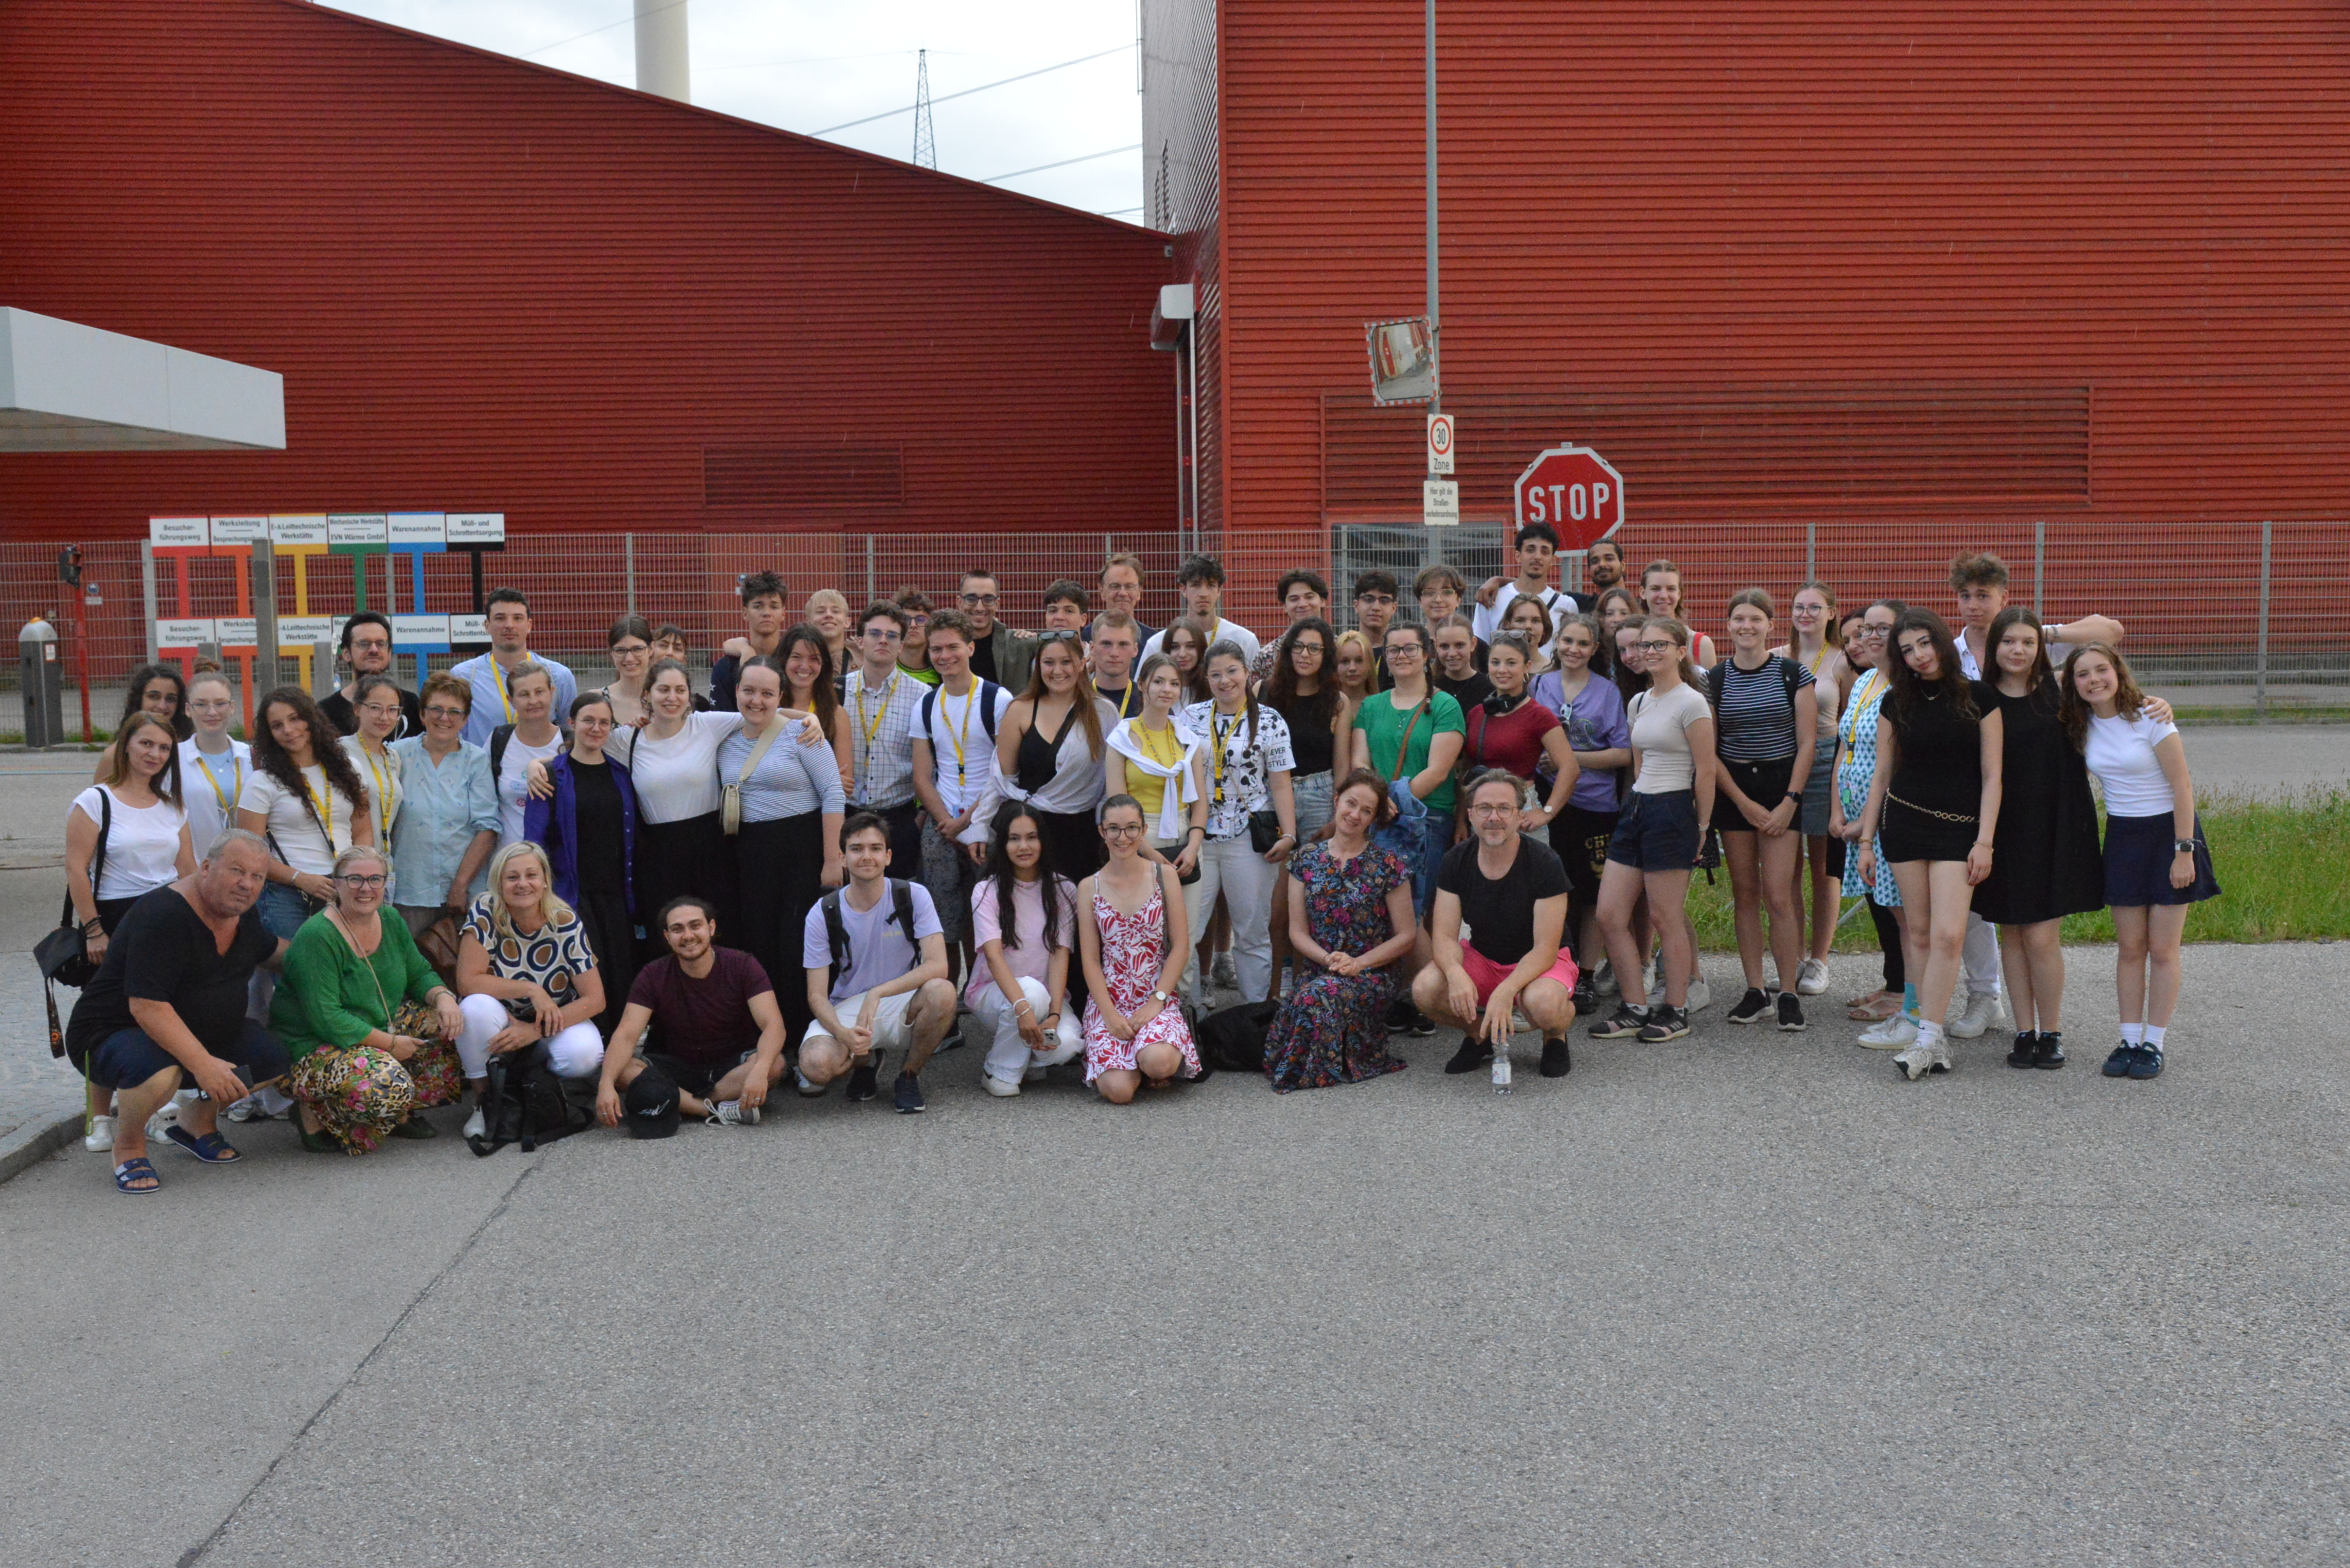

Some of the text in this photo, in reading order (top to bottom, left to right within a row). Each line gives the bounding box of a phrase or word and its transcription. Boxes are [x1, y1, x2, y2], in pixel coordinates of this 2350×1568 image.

[1436, 428, 1446, 444] 30
[1434, 458, 1450, 471] Zone
[1529, 483, 1609, 523] STOP
[1426, 510, 1457, 519] verkehrsordnung
[1268, 758, 1287, 767] STYLE
